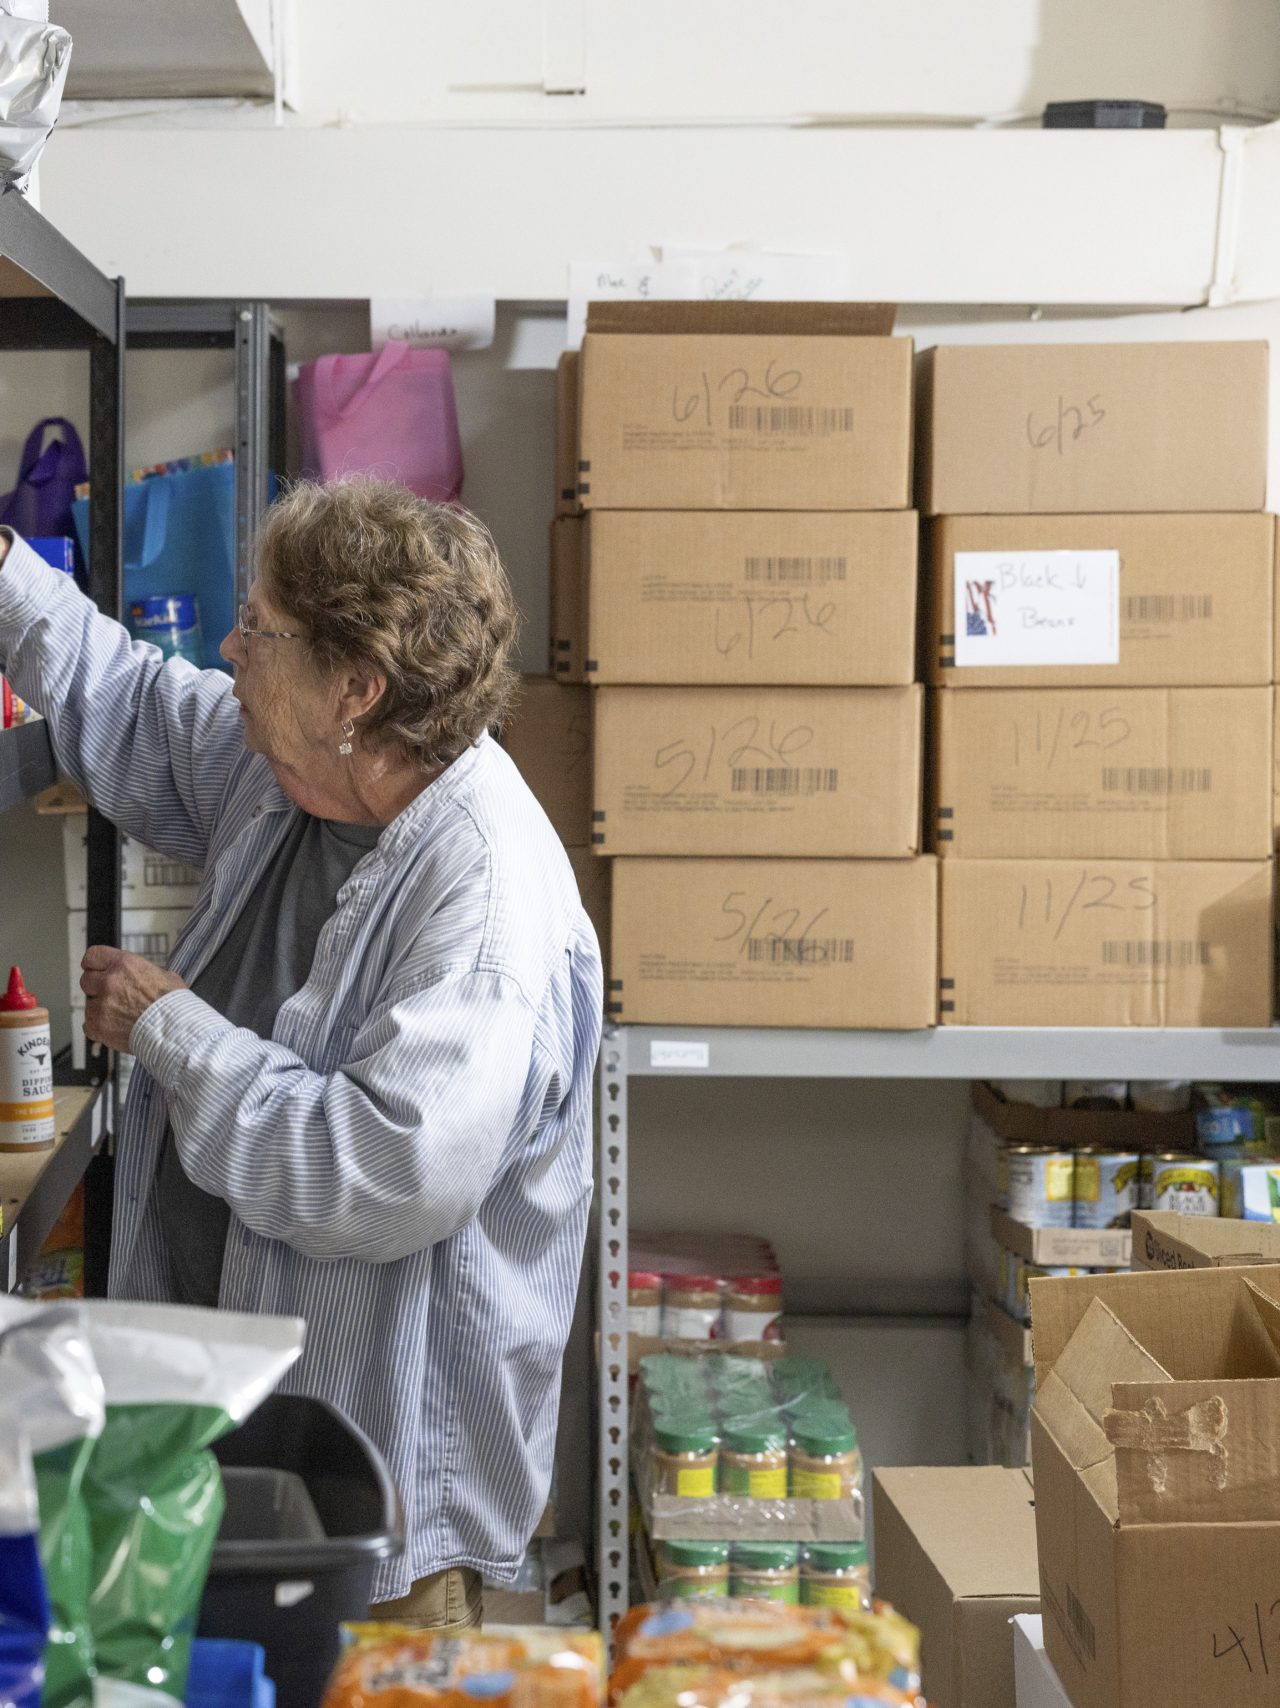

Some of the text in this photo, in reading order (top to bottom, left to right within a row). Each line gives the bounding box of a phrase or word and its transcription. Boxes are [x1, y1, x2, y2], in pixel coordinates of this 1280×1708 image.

[672, 359, 802, 426] 6/26
[1026, 394, 1106, 455] 6/25
[999, 562, 1063, 591] Black
[715, 592, 836, 660] 6/26
[1018, 605, 1076, 630] Beans
[654, 715, 814, 798] 5/26
[1013, 706, 1131, 770] 11/25
[1019, 869, 1158, 941] 11/25
